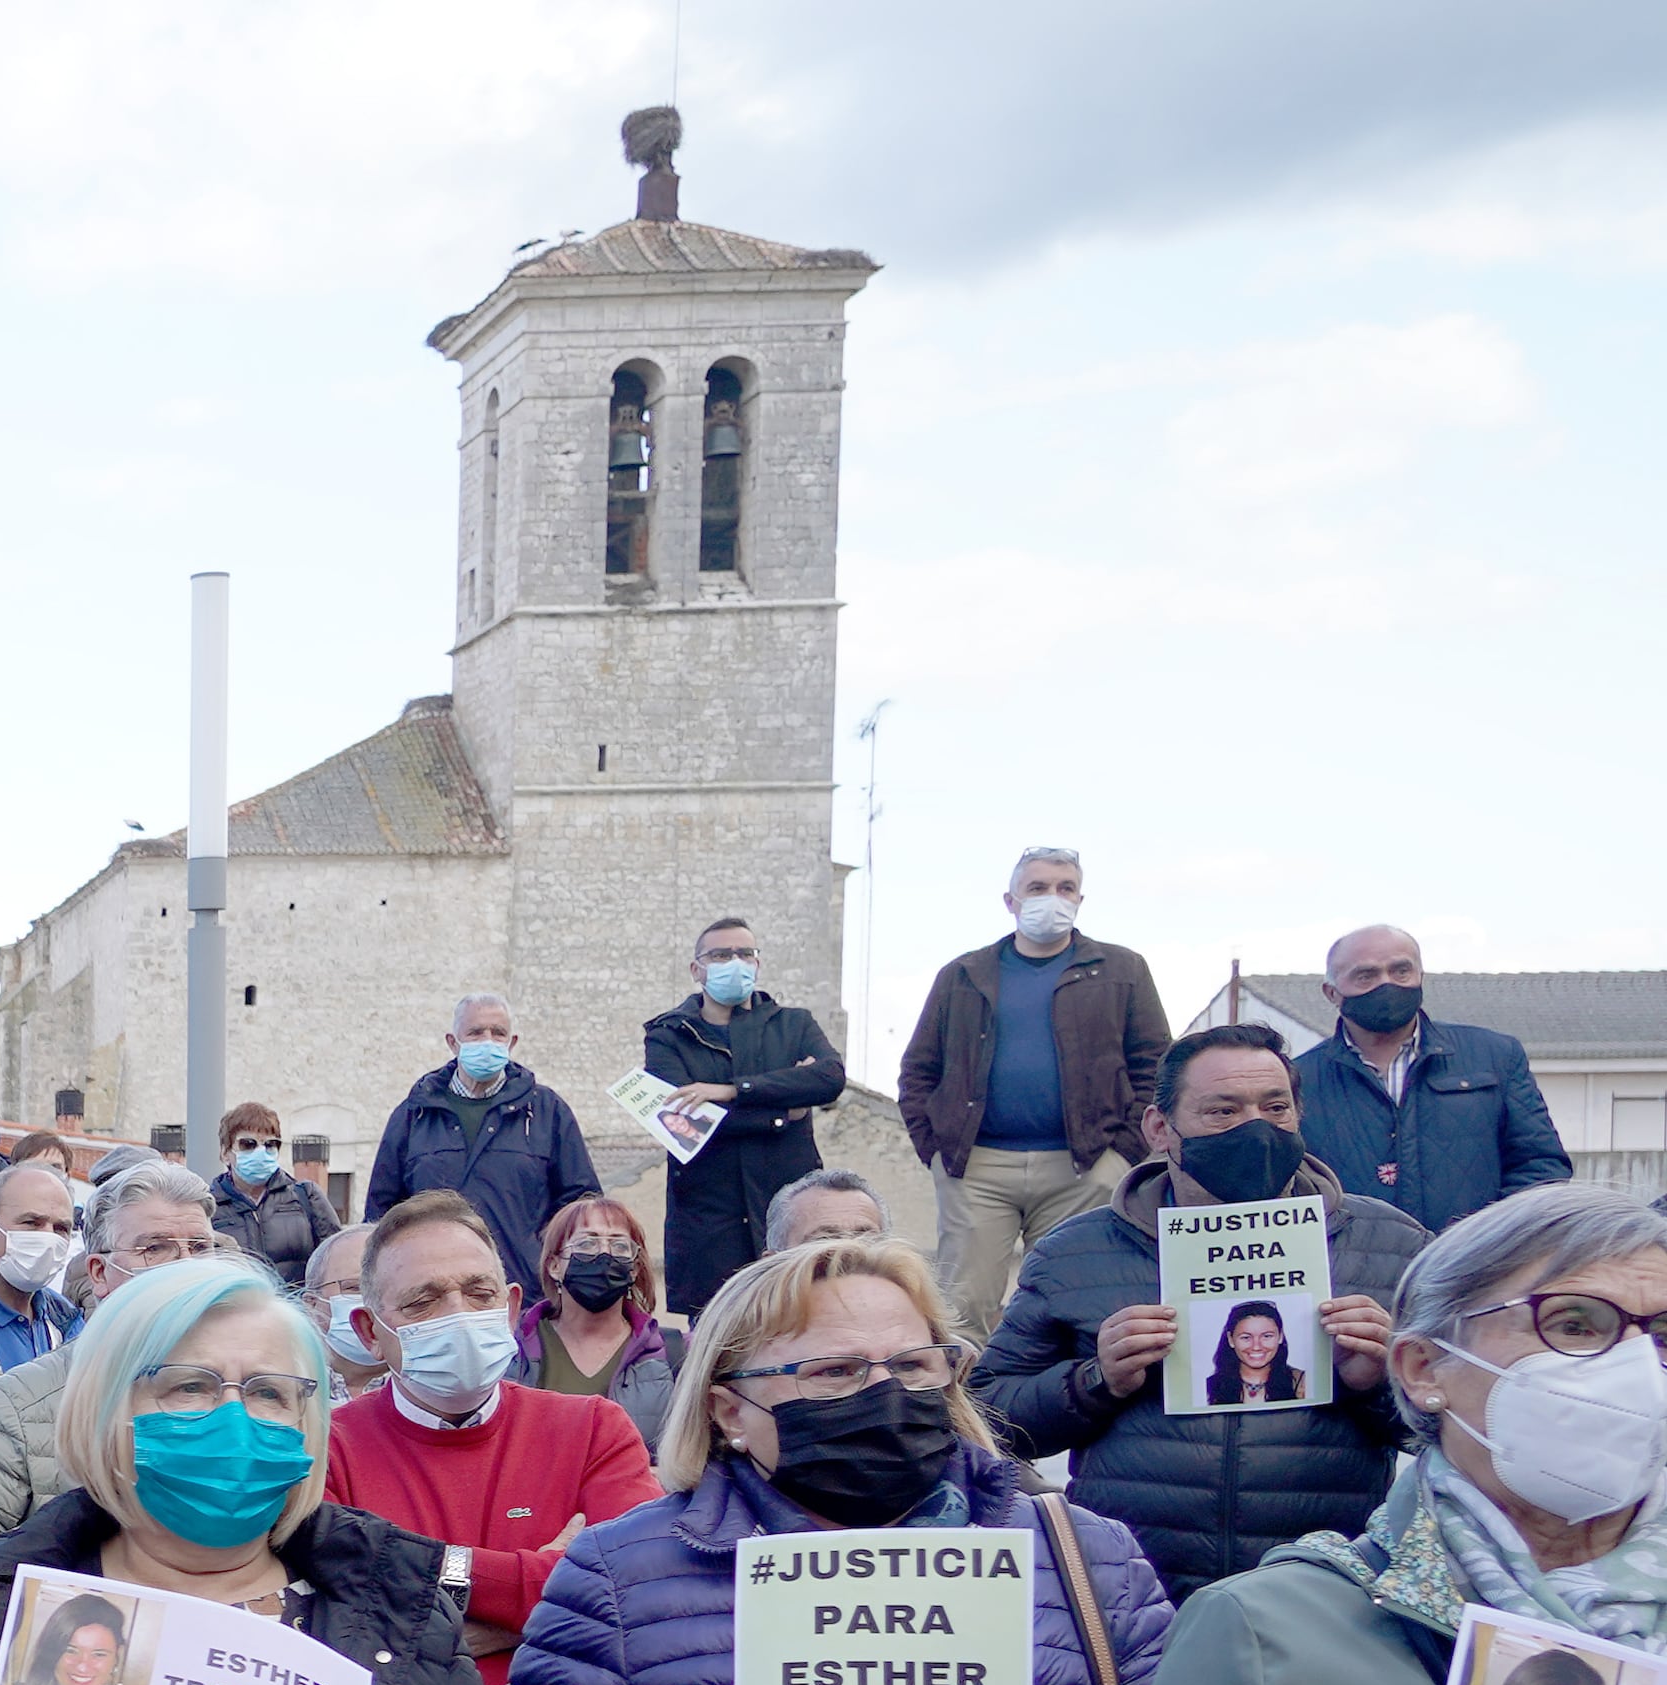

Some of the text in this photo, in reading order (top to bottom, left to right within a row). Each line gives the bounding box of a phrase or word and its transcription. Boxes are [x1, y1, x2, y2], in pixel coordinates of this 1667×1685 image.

[1168, 1207, 1319, 1235] #JUSTICIA
[1208, 1241, 1286, 1263] PARA
[1190, 1270, 1306, 1294] ESTHER
[750, 1547, 1021, 1584] #JUSTICIA
[814, 1605, 955, 1635] PARA
